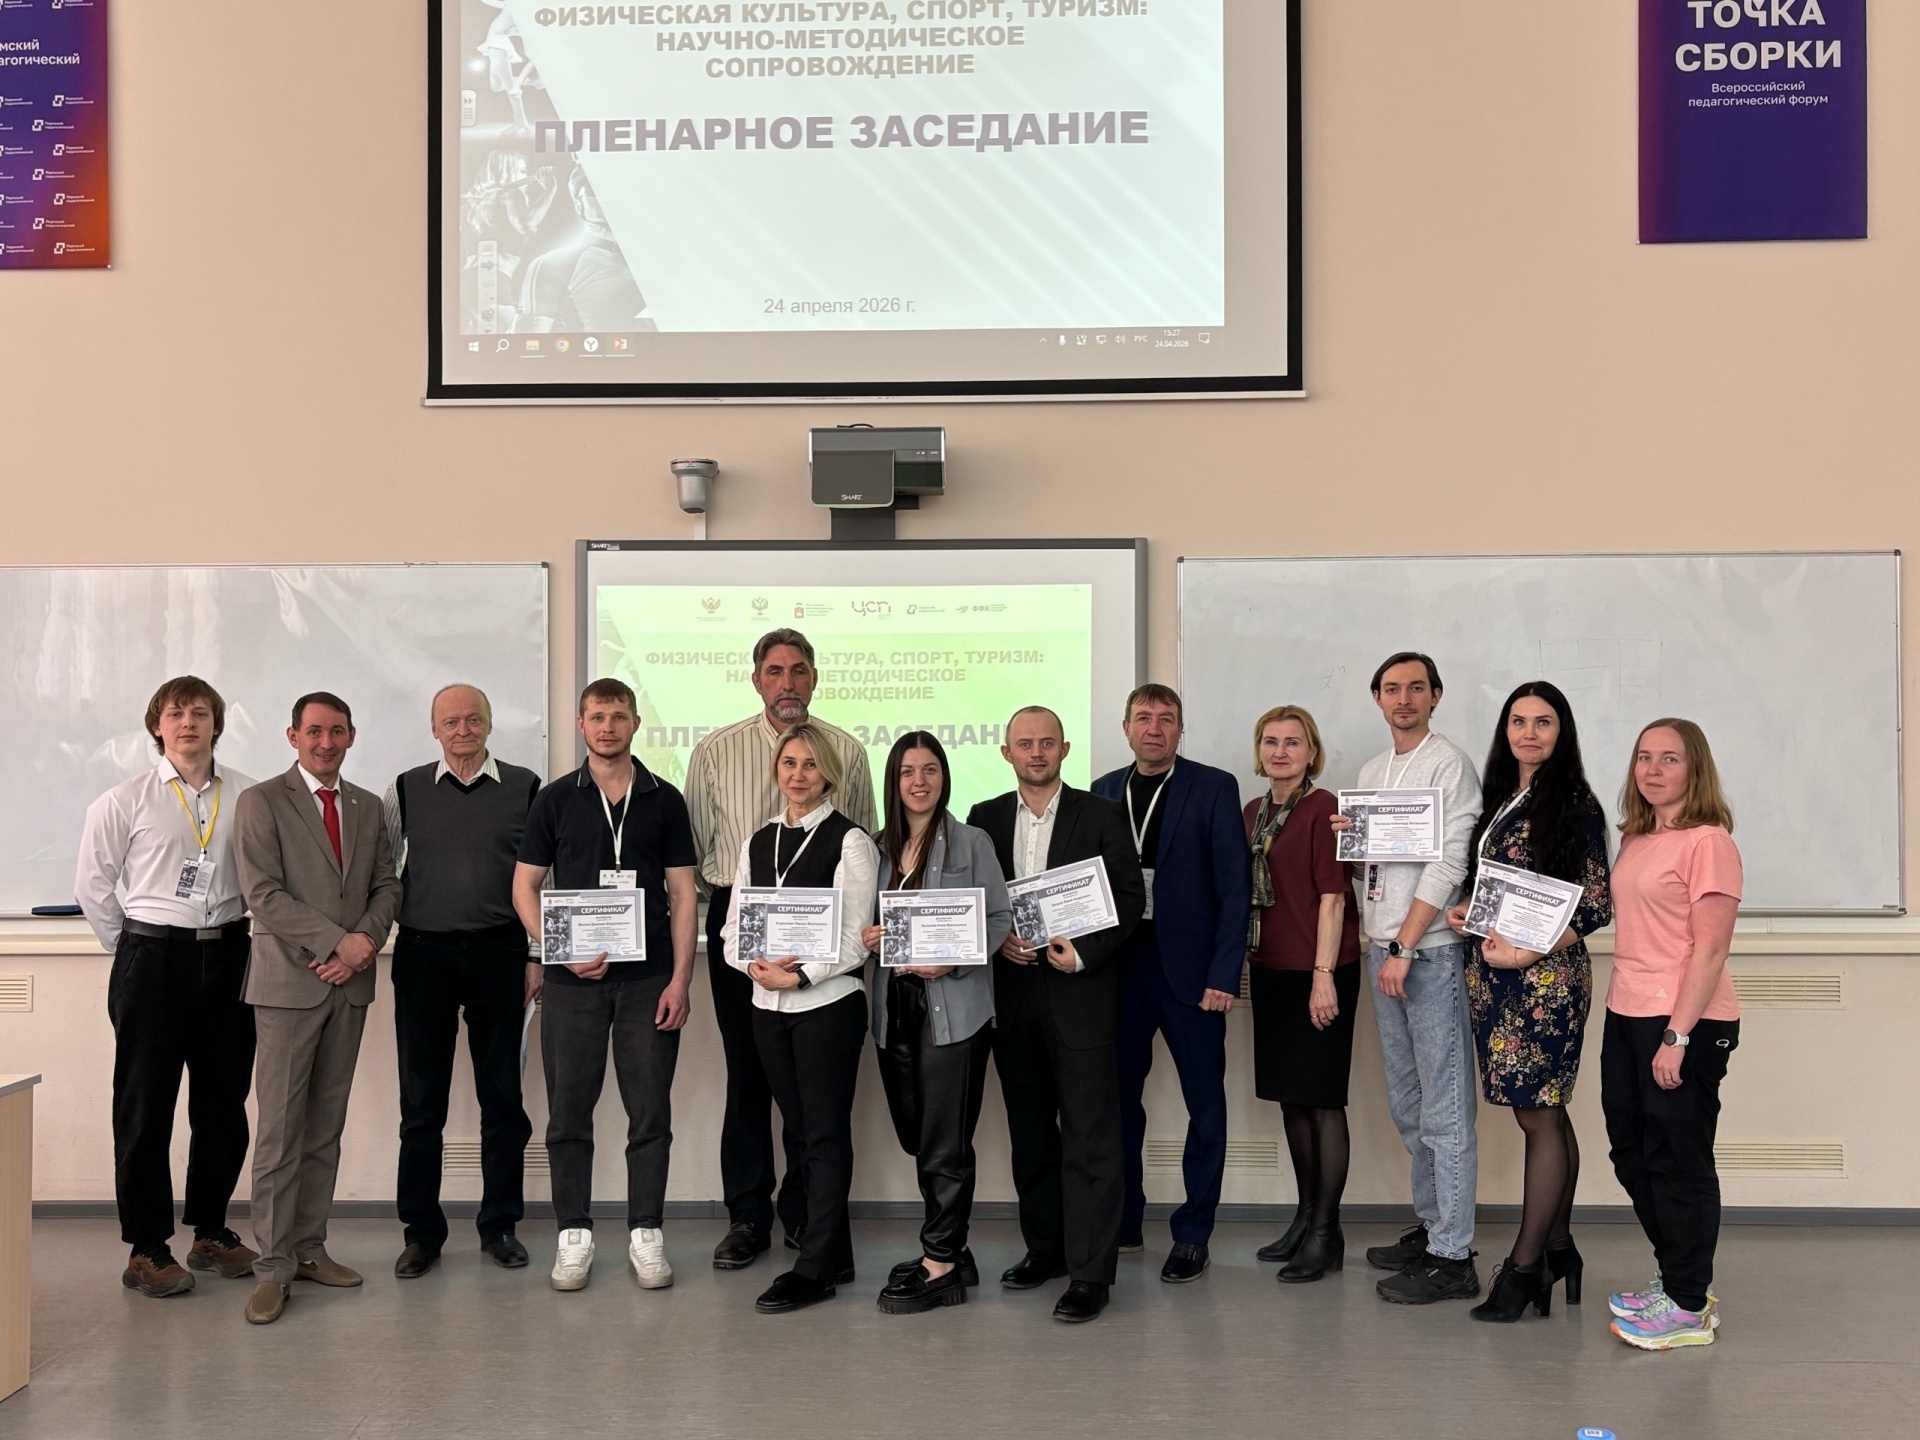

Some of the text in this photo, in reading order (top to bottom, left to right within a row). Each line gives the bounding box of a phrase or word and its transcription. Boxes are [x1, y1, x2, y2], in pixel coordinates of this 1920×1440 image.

[534, 0, 1147, 26] ФИЗИЧЕСКАЯ КУЛЬТУРА, СПОРТ, ТУРИЗМ:
[1687, 0, 1826, 28] ТОЧКА
[656, 26, 1024, 51] НАУЧНО-МЕТОДИЧЕСКОЕ
[1675, 40, 1842, 72] СБОРКИ
[705, 54, 974, 78] СОПРОВОЖДЕНИЕ
[1711, 81, 1806, 94] Всероссийский
[1688, 94, 1829, 108] педагогический форум
[535, 111, 1149, 153] ПЛЕНАРНОЕ ЗАСЕДАНИЕ
[763, 298, 915, 316] 24 апреля 2026 г.
[1134, 335, 1148, 343] РУС
[646, 652, 752, 665] ФИЗИЧЕСК
[890, 651, 959, 667] СПОРТ,
[964, 650, 1044, 664] ТУРИЗМ:
[1046, 878, 1090, 895] СЕРТИФИКАТ
[1515, 887, 1561, 906] СЕРТИФИКАТ
[581, 906, 626, 914] СЕРТИФИКАТ
[777, 905, 824, 913] СЕРТИФИКАТ
[920, 906, 967, 915] СЕРТИФИКАТ
